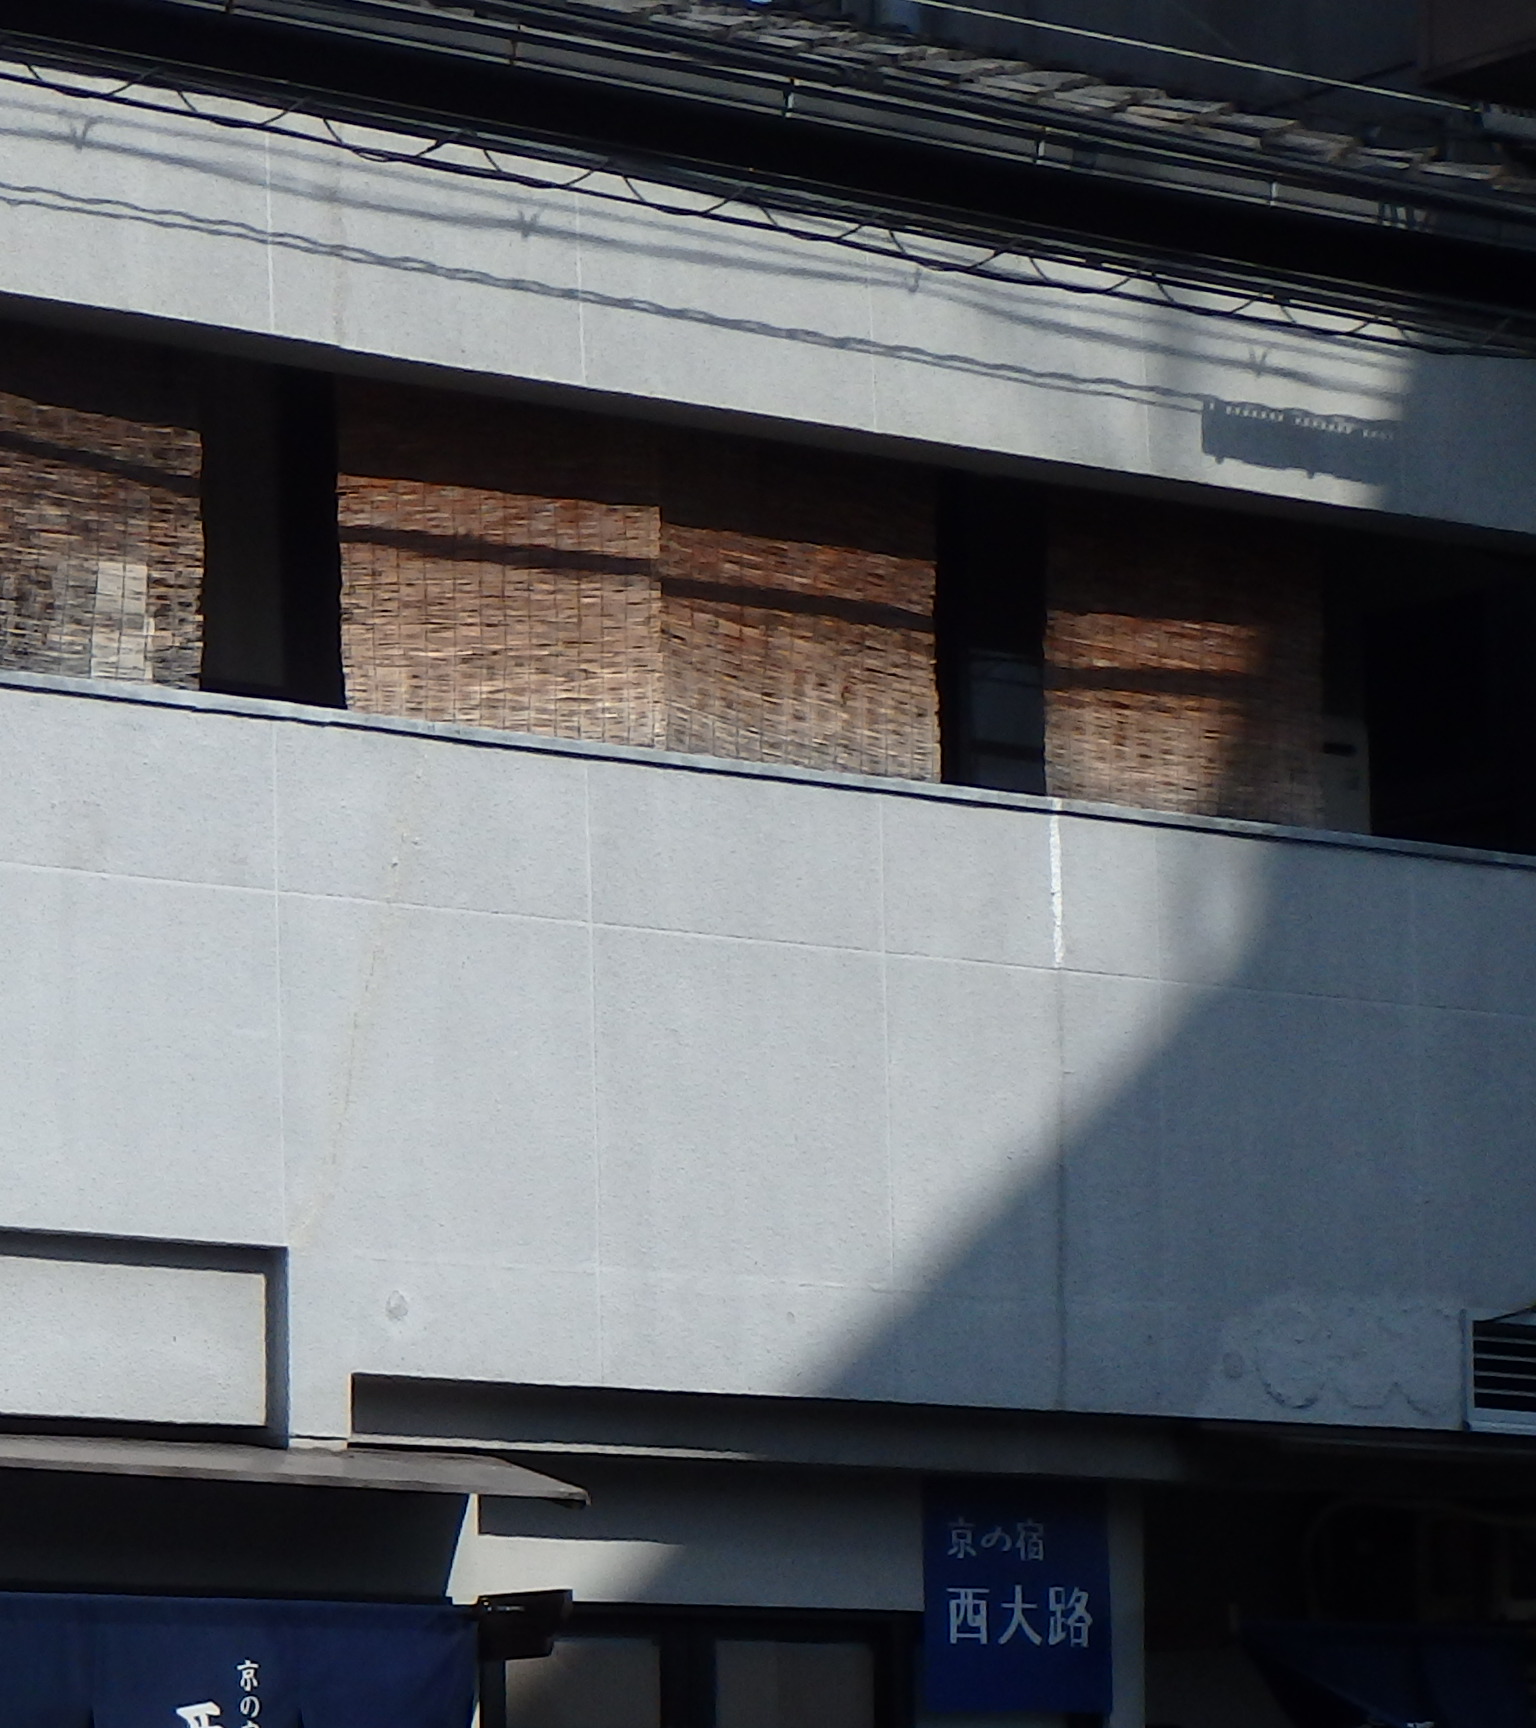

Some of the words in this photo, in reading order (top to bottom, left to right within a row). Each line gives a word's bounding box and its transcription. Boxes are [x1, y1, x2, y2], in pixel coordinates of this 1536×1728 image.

[947, 1516, 1045, 1562] 京の宿
[946, 1584, 1094, 1648] 西大路
